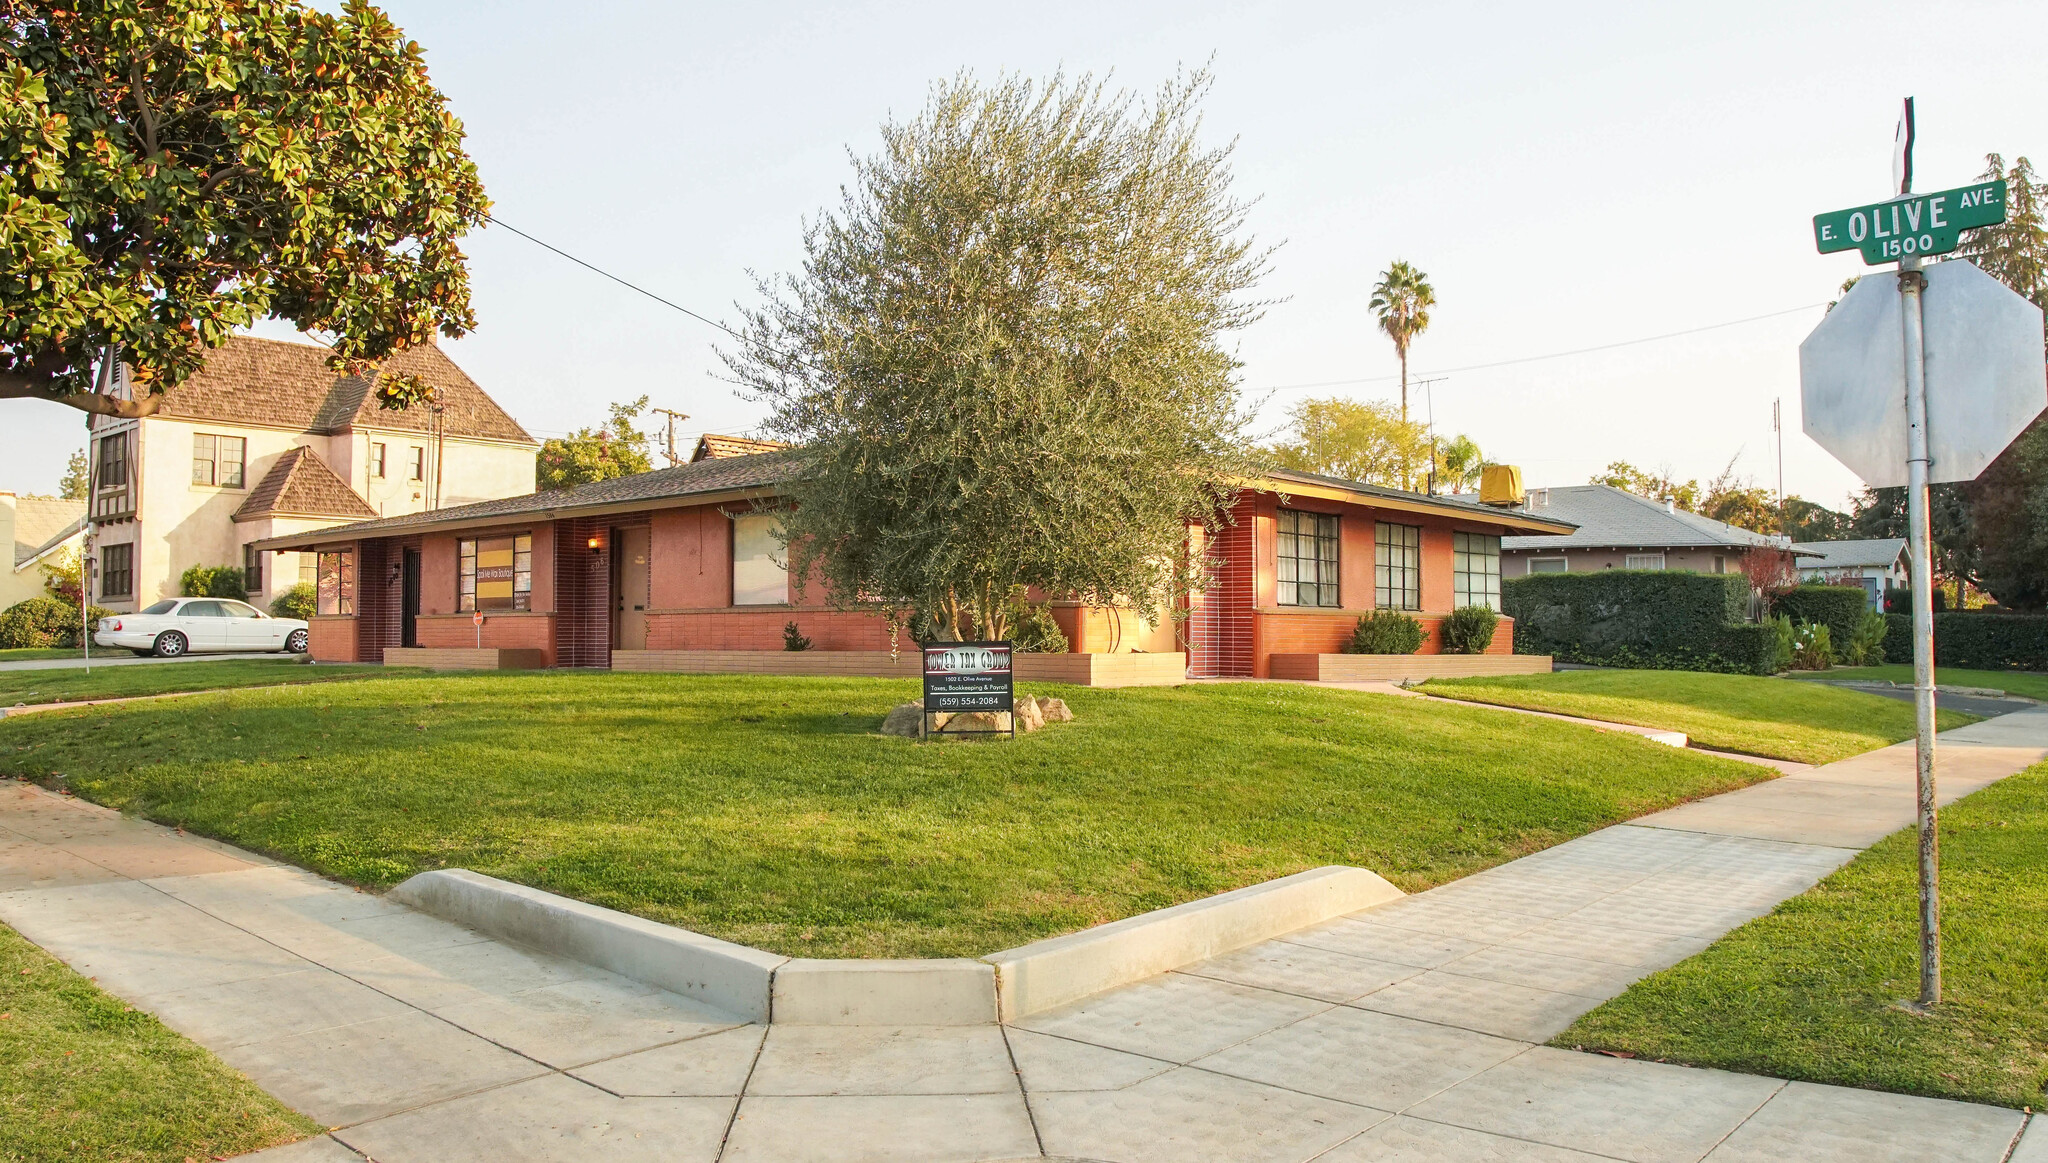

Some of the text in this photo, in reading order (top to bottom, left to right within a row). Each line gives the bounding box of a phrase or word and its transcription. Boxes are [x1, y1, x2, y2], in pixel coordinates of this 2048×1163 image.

[1821, 187, 2000, 243] E. OLIVE AVE.
[1882, 234, 1933, 257] 1500
[927, 651, 1011, 671] TOWER TAX GROUP
[940, 698, 959, 706] (559)
